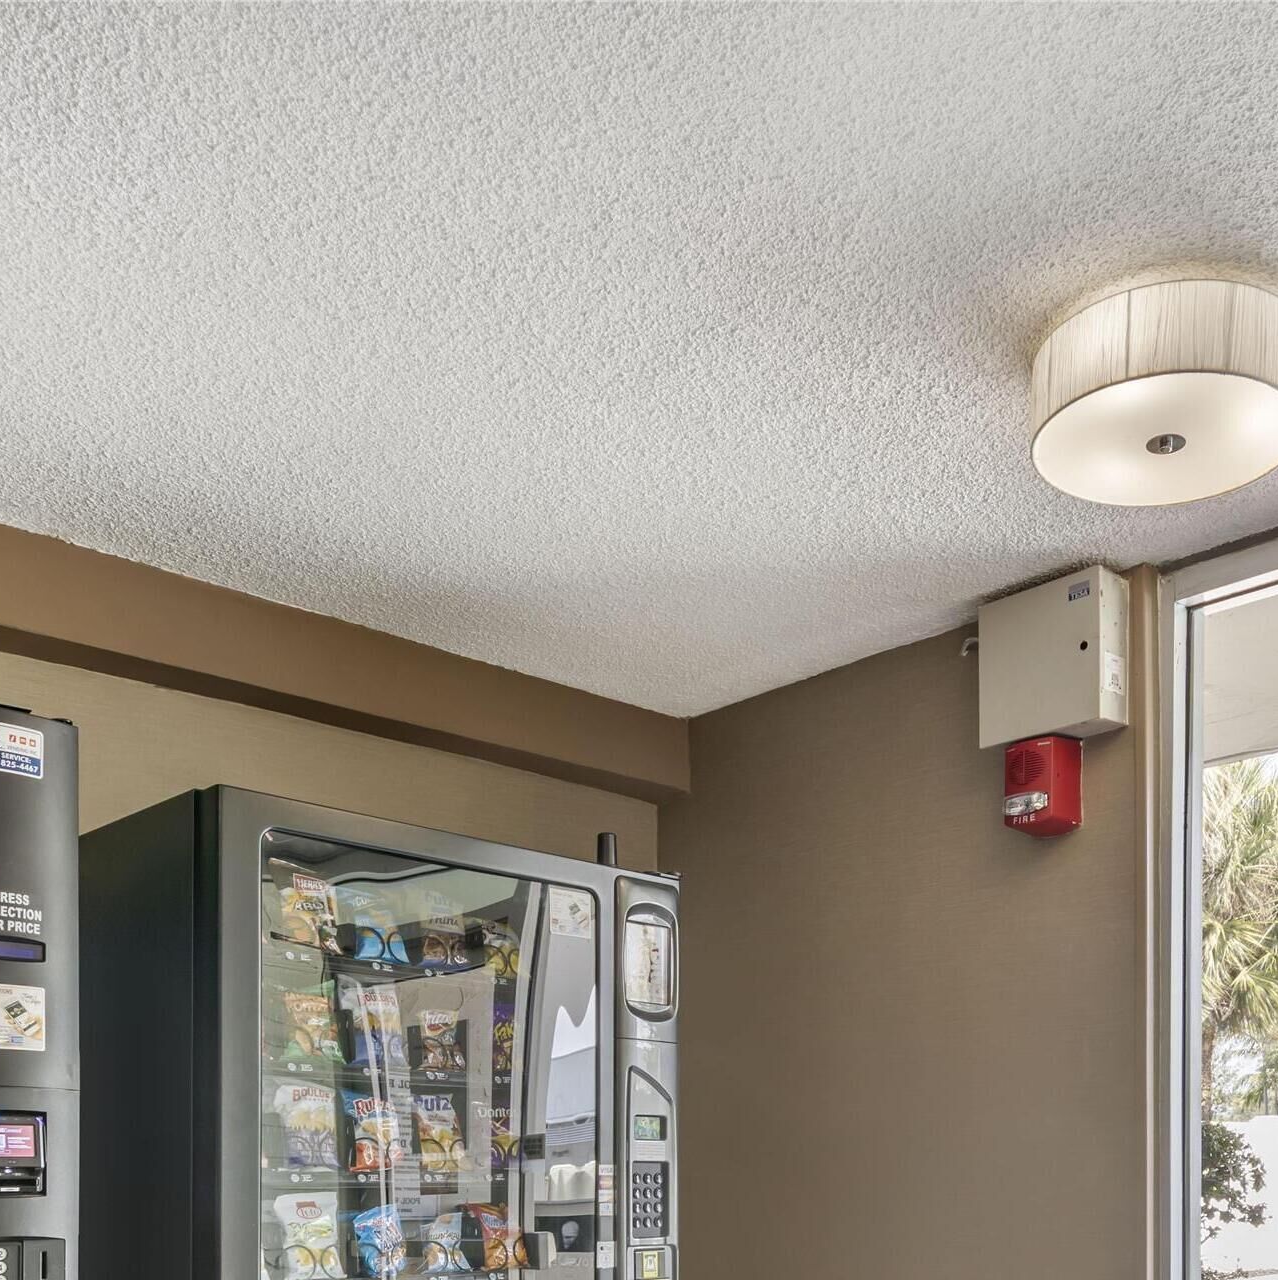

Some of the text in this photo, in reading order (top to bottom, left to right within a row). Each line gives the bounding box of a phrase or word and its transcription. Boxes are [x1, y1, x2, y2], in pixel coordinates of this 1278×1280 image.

[1, 751, 32, 764] SERVICE:
[1013, 813, 1036, 825] FIRE
[7, 920, 41, 935] PRICE
